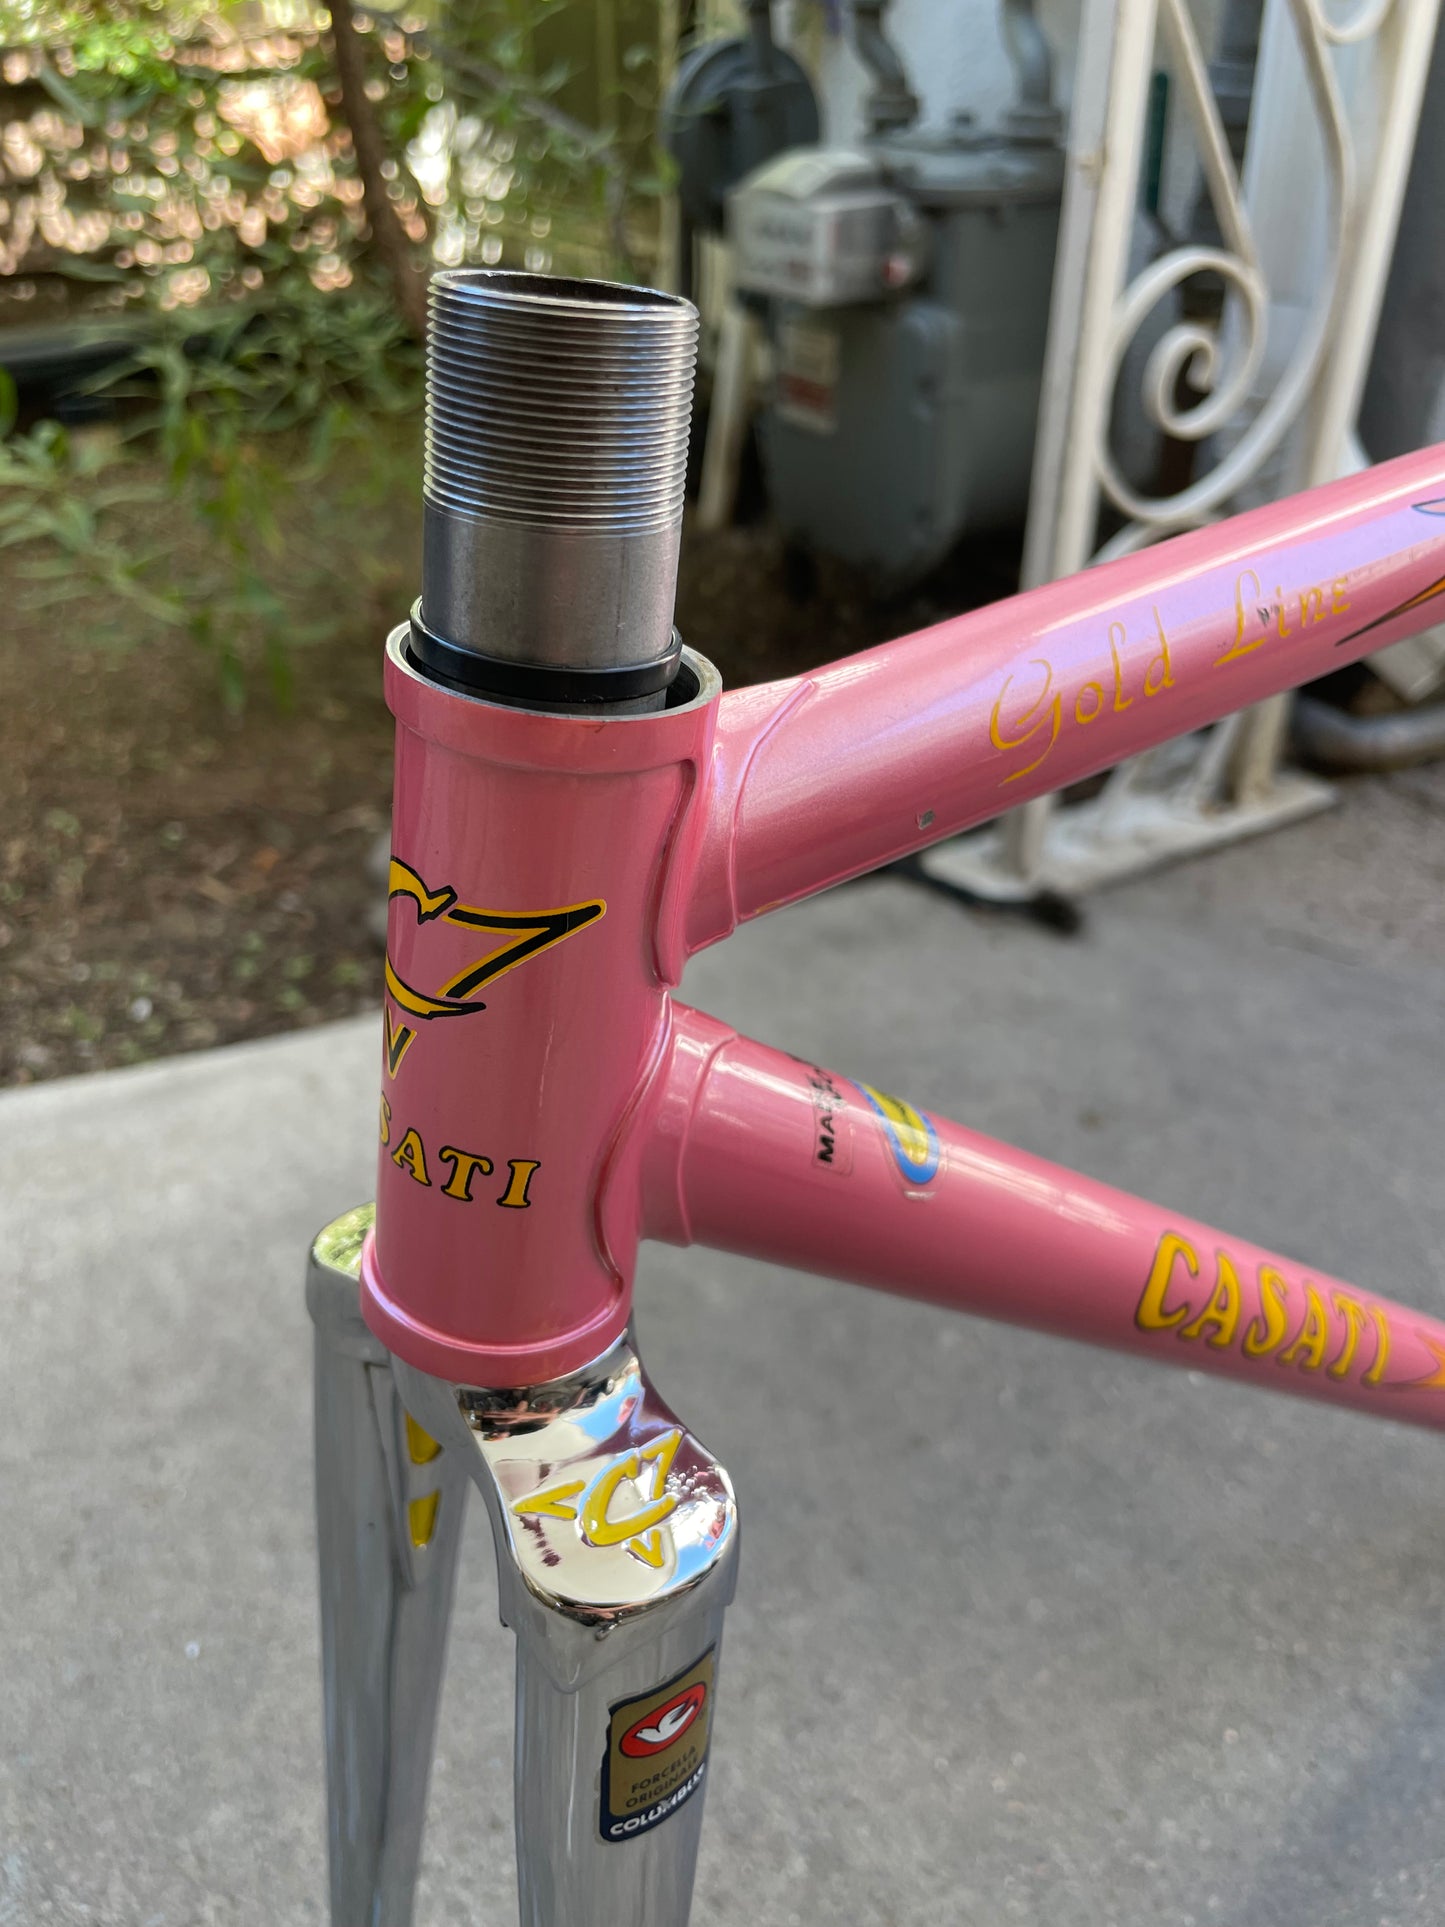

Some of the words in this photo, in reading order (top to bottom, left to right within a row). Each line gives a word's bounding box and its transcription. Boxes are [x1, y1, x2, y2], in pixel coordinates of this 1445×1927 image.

[989, 606, 1175, 786] Gold
[1213, 568, 1352, 668] Line
[1135, 1231, 1391, 1387] CASATI
[631, 1745, 696, 1794] FORCELLA
